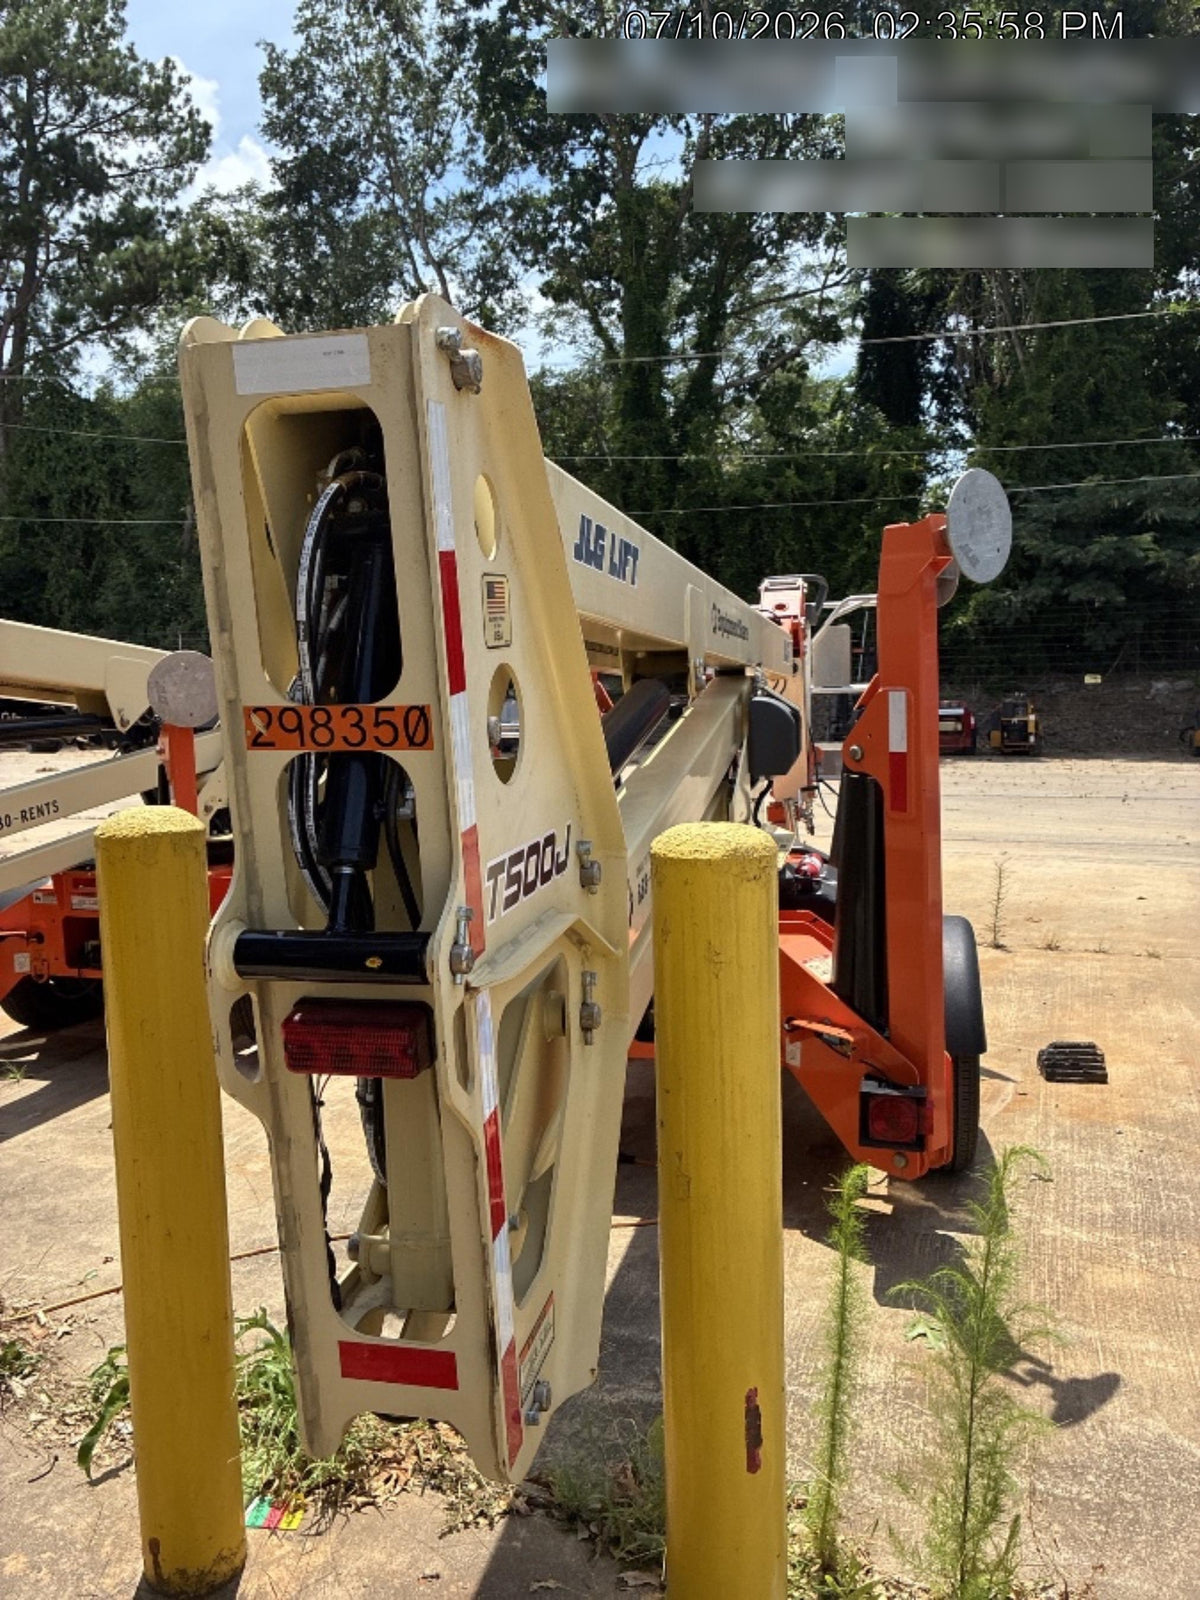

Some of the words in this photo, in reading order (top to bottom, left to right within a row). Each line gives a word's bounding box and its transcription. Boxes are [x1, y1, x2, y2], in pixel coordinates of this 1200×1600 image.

[573, 512, 607, 573] JLG
[607, 531, 640, 587] LIFT
[250, 705, 430, 748] 298350
[485, 822, 571, 923] T500J
